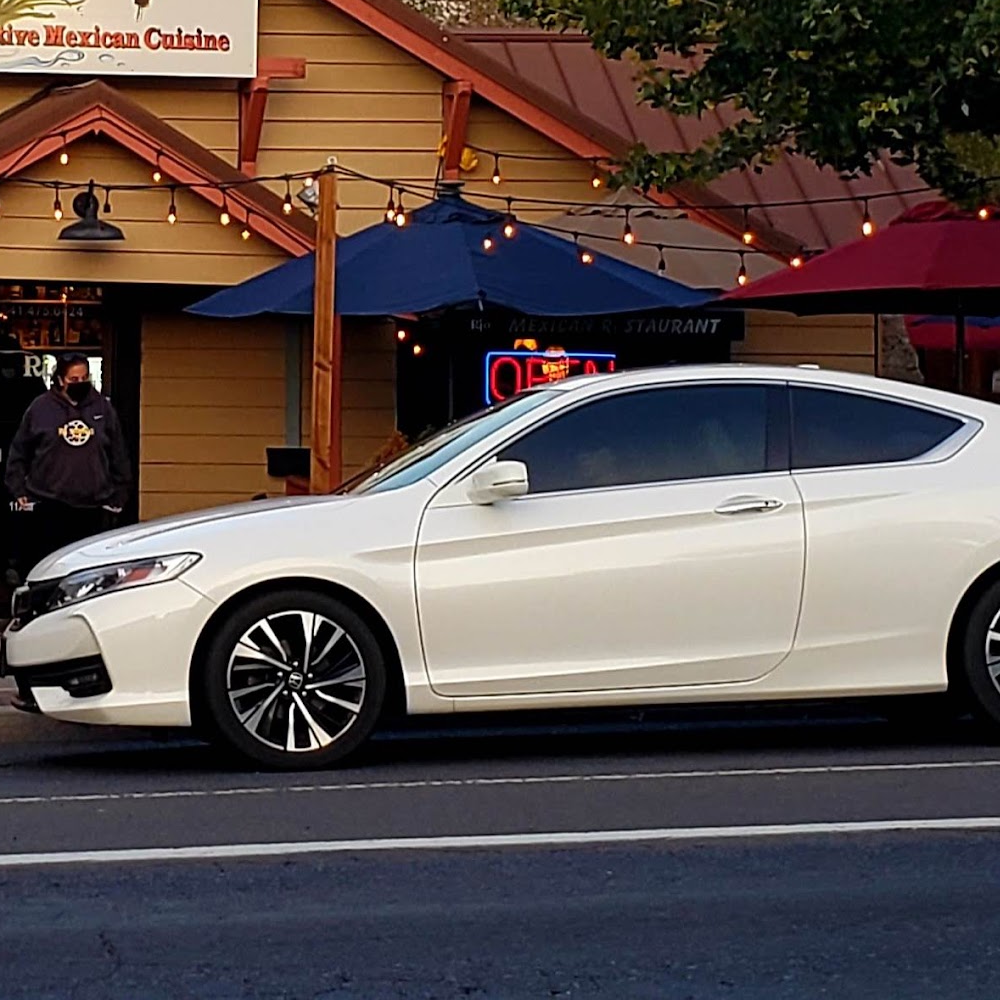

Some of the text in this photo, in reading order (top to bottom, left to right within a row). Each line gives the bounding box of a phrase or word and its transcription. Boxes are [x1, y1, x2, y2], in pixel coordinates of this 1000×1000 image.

[43, 25, 140, 50] Mexican
[143, 27, 231, 51] Cuisine
[508, 317, 722, 335] MEXICAN RSTAURANT
